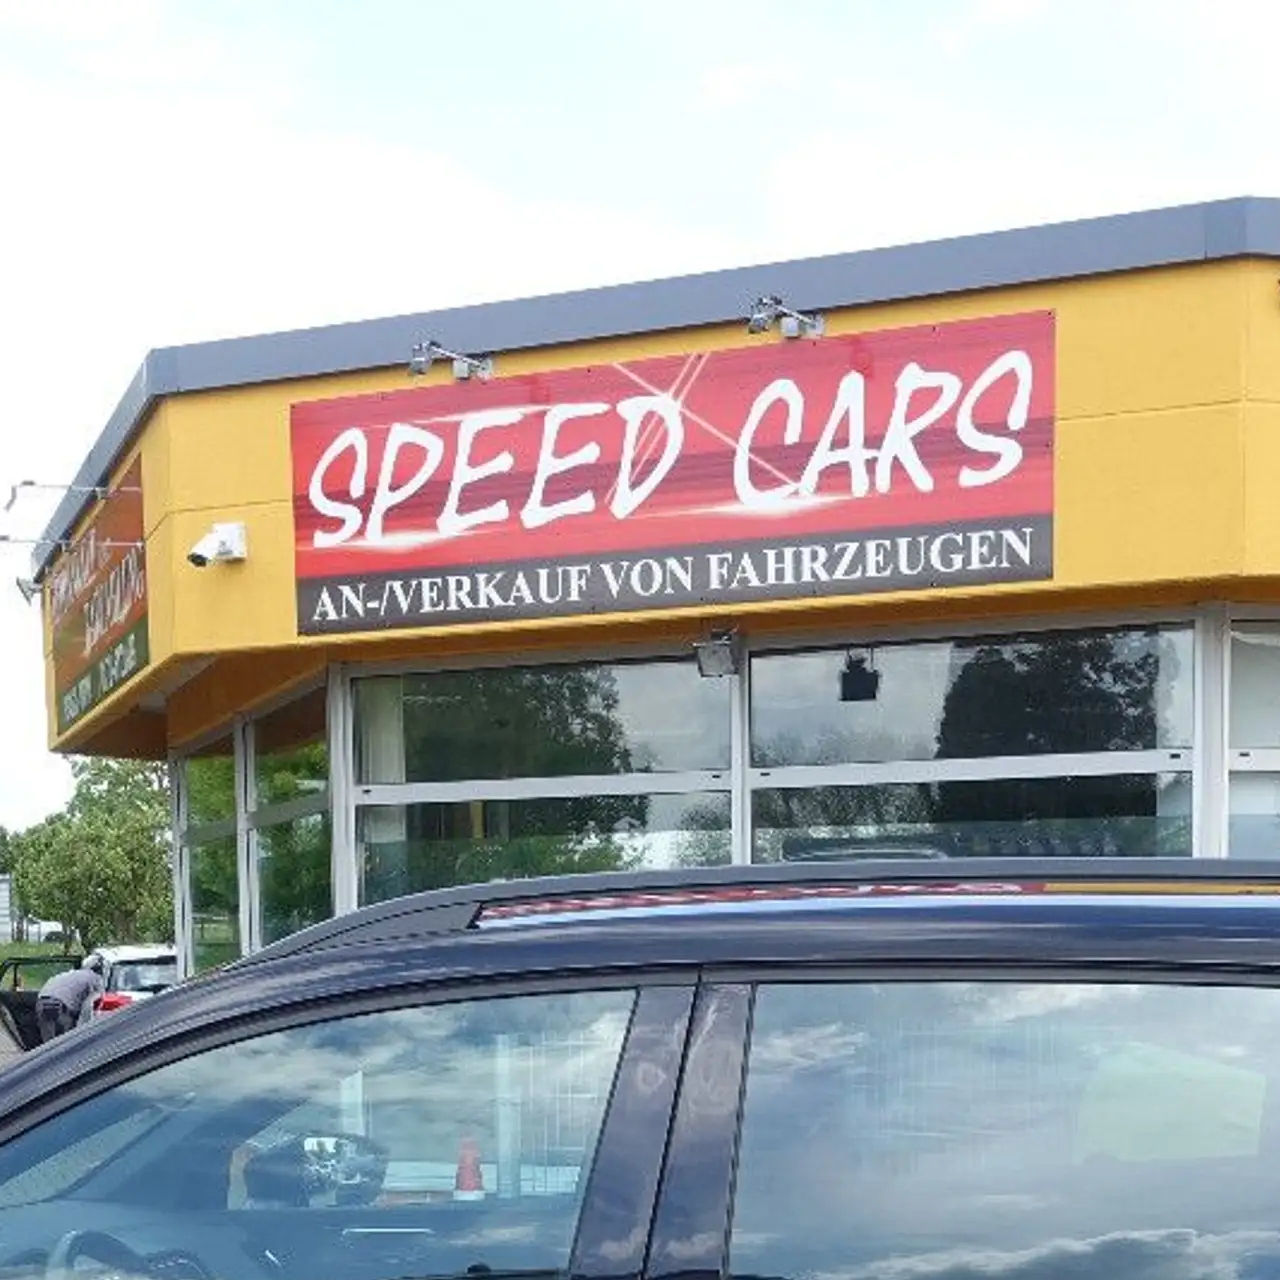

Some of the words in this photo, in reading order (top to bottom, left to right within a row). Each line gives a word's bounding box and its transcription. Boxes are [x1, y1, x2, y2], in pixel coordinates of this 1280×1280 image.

[308, 393, 685, 548] SPEED
[733, 349, 1032, 511] CARS
[312, 563, 592, 622] AN-/VERKAUF
[598, 555, 695, 599] VON
[706, 527, 1035, 591] FAHRZEUGEN
